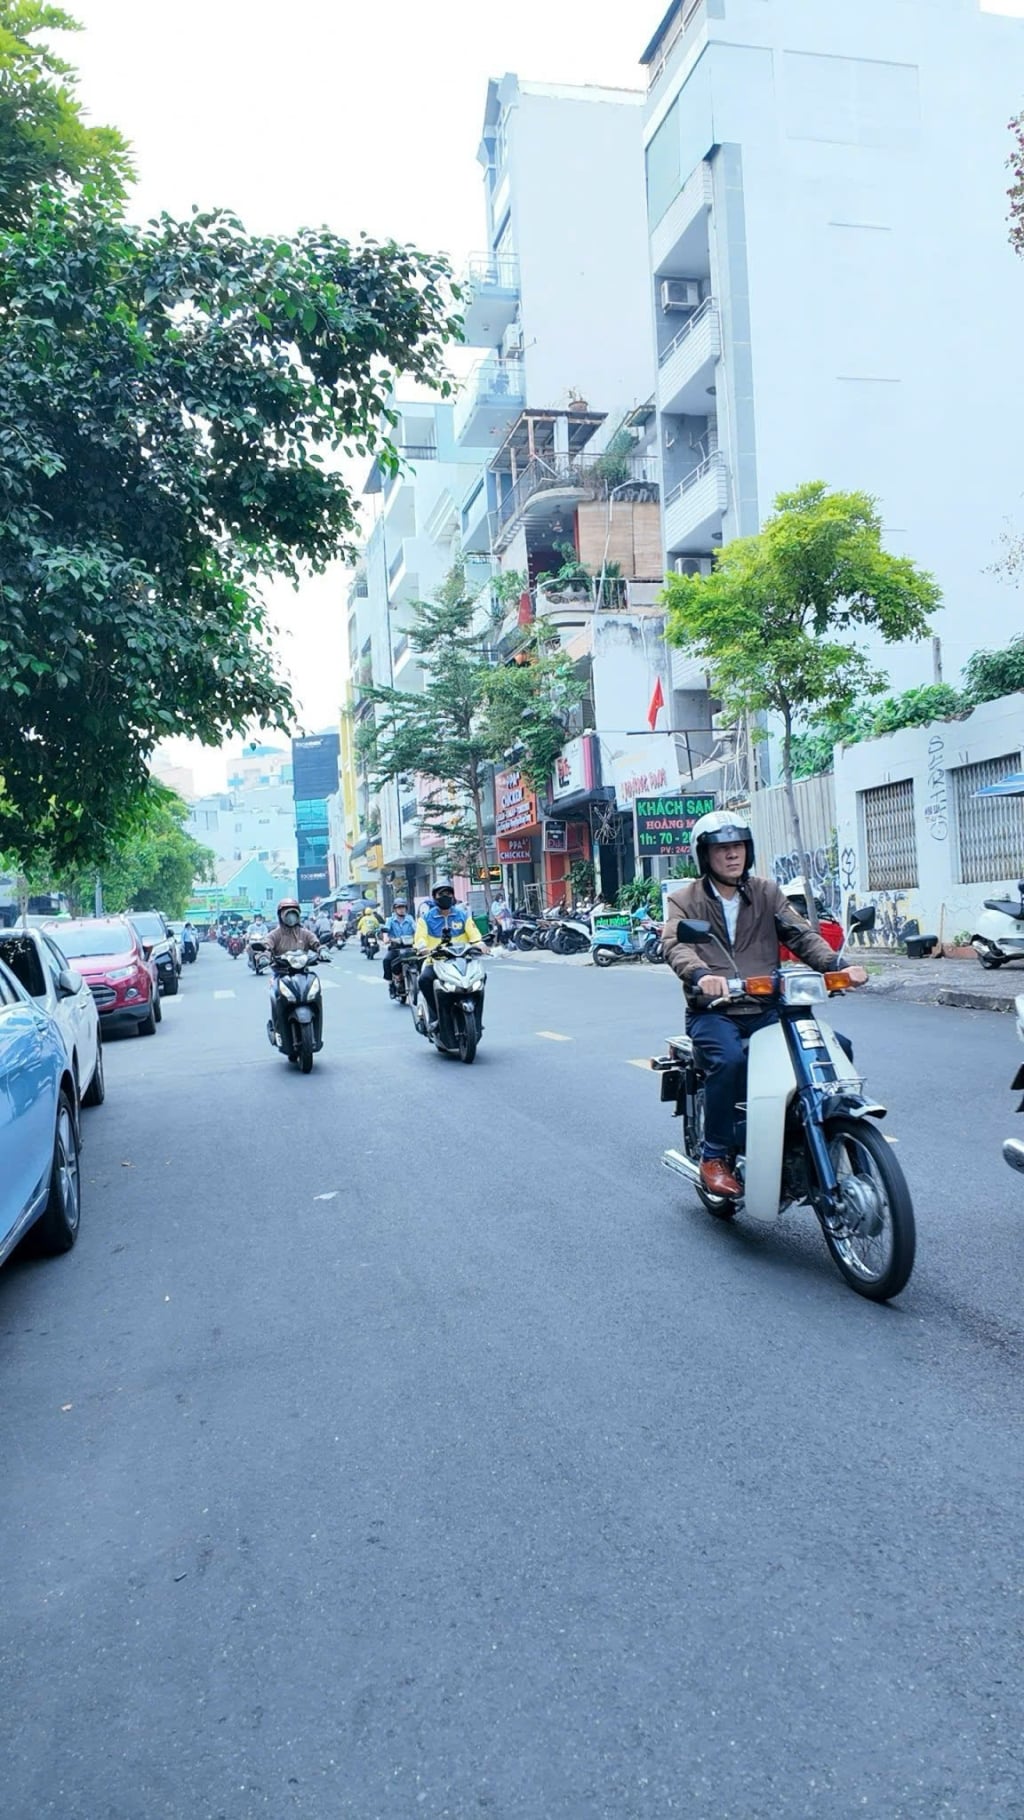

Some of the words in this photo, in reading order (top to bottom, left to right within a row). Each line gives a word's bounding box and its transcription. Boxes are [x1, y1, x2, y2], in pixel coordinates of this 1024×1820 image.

[637, 798, 684, 816] KHÁCH
[686, 800, 713, 816] SẠN
[646, 818, 684, 829] HOÀNG
[640, 832, 657, 845] 1h:
[659, 831, 673, 844] 70
[500, 851, 530, 859] CHICKEN
[660, 846, 674, 854] PV:
